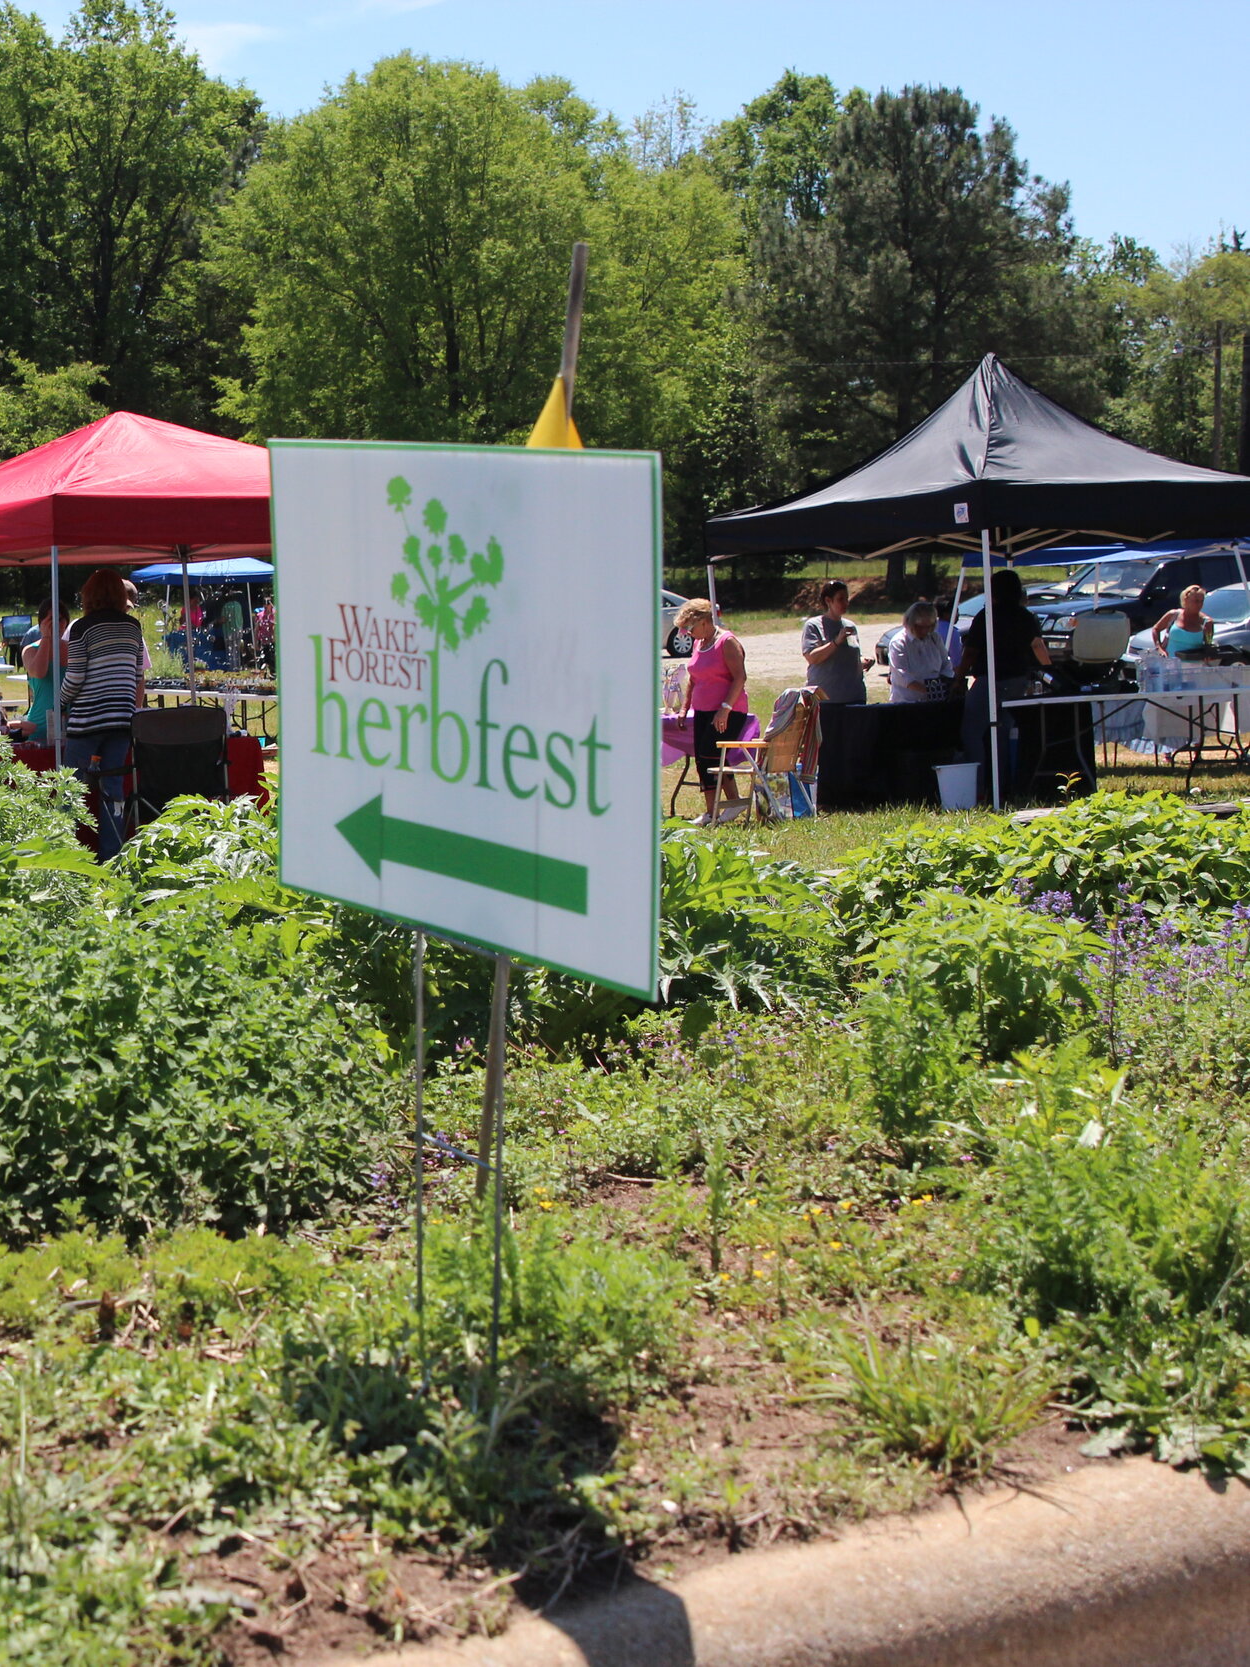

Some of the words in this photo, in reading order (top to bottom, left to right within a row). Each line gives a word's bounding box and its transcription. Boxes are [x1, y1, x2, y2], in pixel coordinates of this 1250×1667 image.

[337, 603, 420, 655] WAKE
[327, 637, 427, 691] FOREST
[307, 633, 612, 817] herbfest
